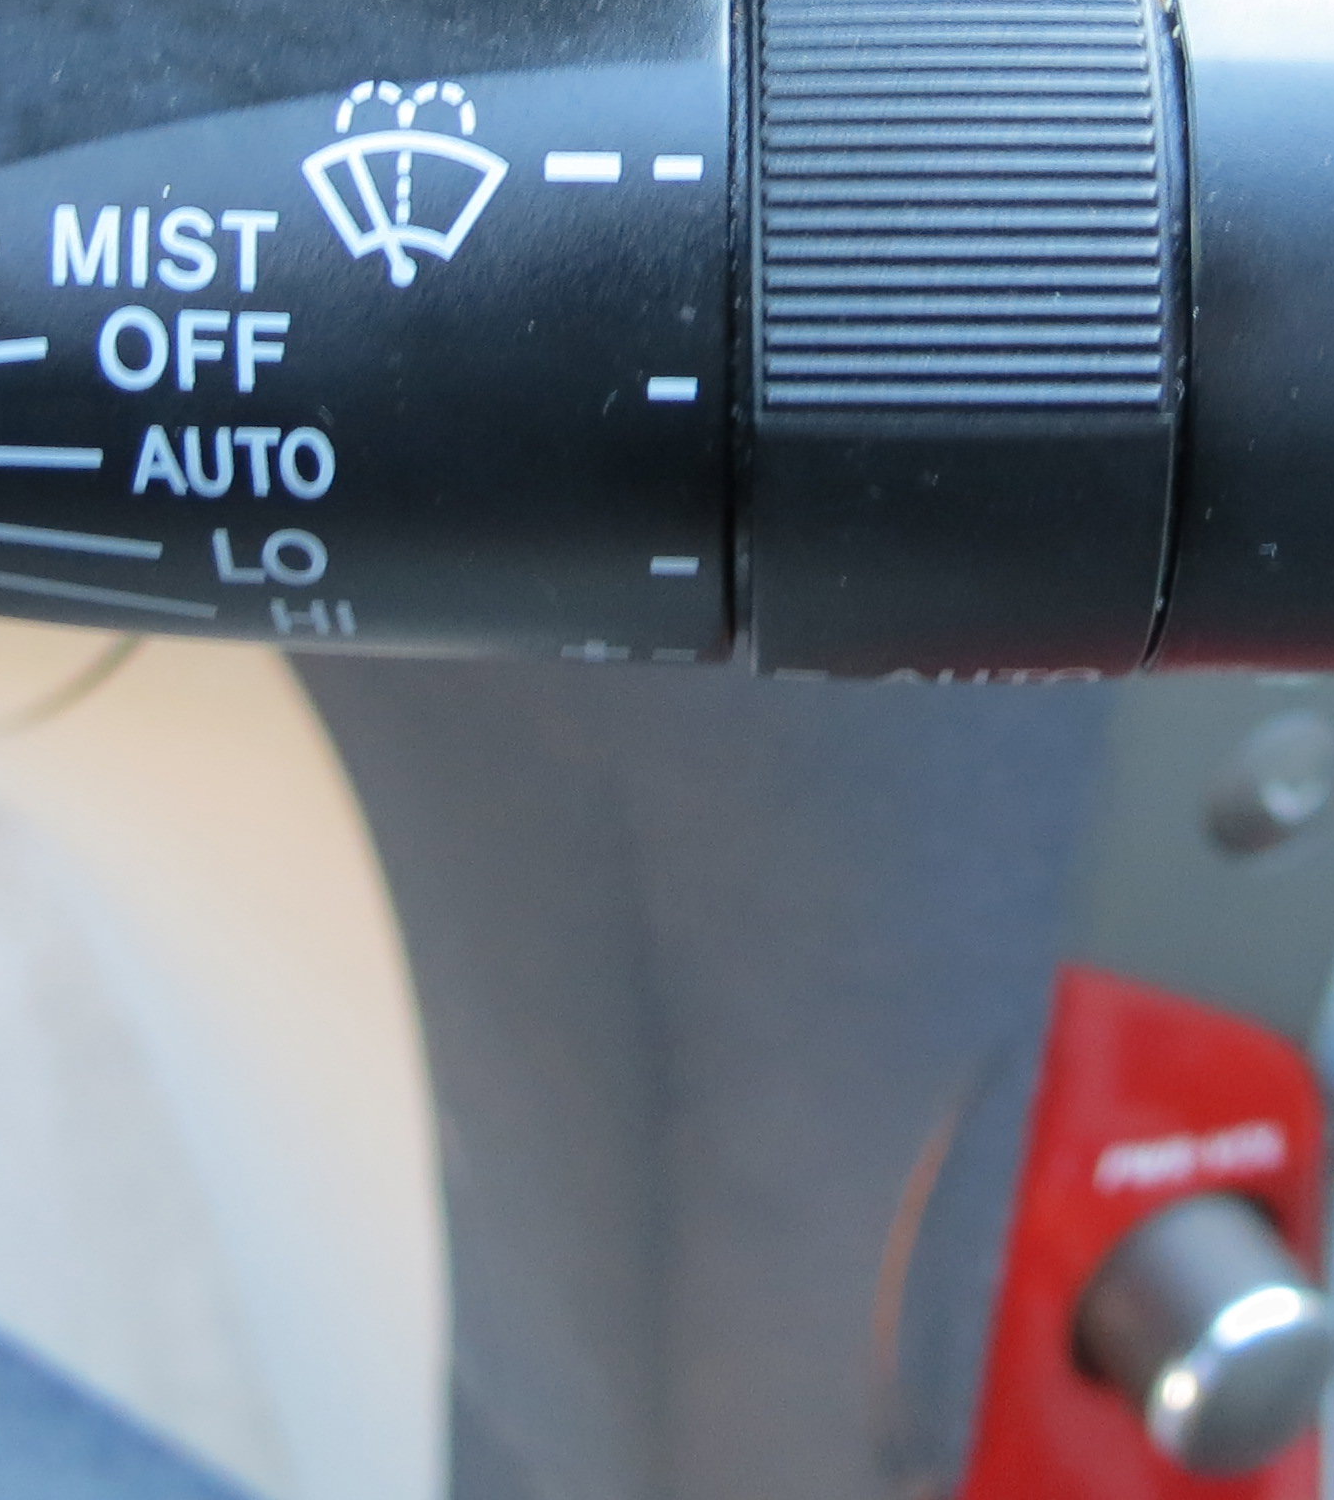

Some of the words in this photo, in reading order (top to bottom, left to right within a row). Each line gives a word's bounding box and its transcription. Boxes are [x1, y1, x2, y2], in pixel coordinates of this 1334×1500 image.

[52, 203, 279, 293] MIST
[98, 304, 291, 393] OFF
[132, 423, 336, 500] AUTO
[211, 526, 328, 586] LO
[270, 597, 357, 636] HI
